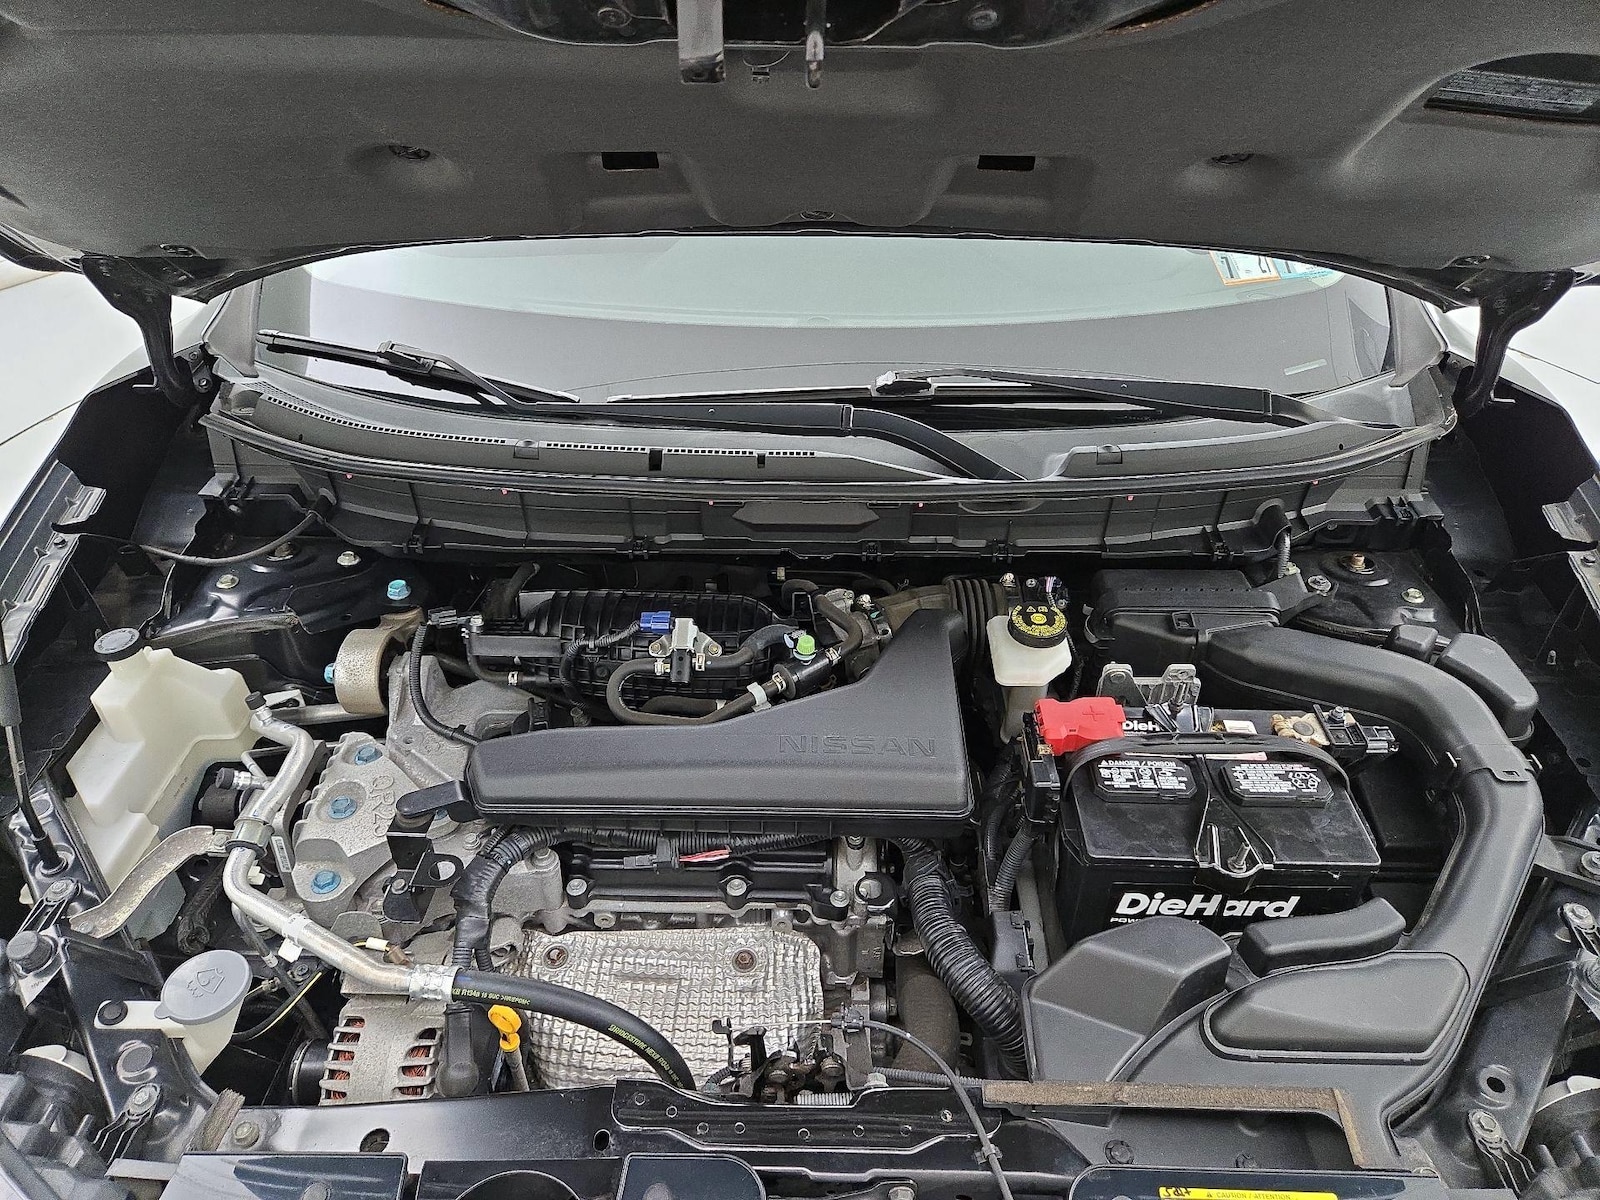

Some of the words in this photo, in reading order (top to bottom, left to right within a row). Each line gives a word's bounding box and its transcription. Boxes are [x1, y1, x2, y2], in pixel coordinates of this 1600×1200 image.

[778, 734, 936, 757] NISSAN
[1115, 891, 1301, 918] DieHard
[607, 1024, 647, 1050] BRIDGESTONE
[1253, 1192, 1291, 1200] ATTENTION
